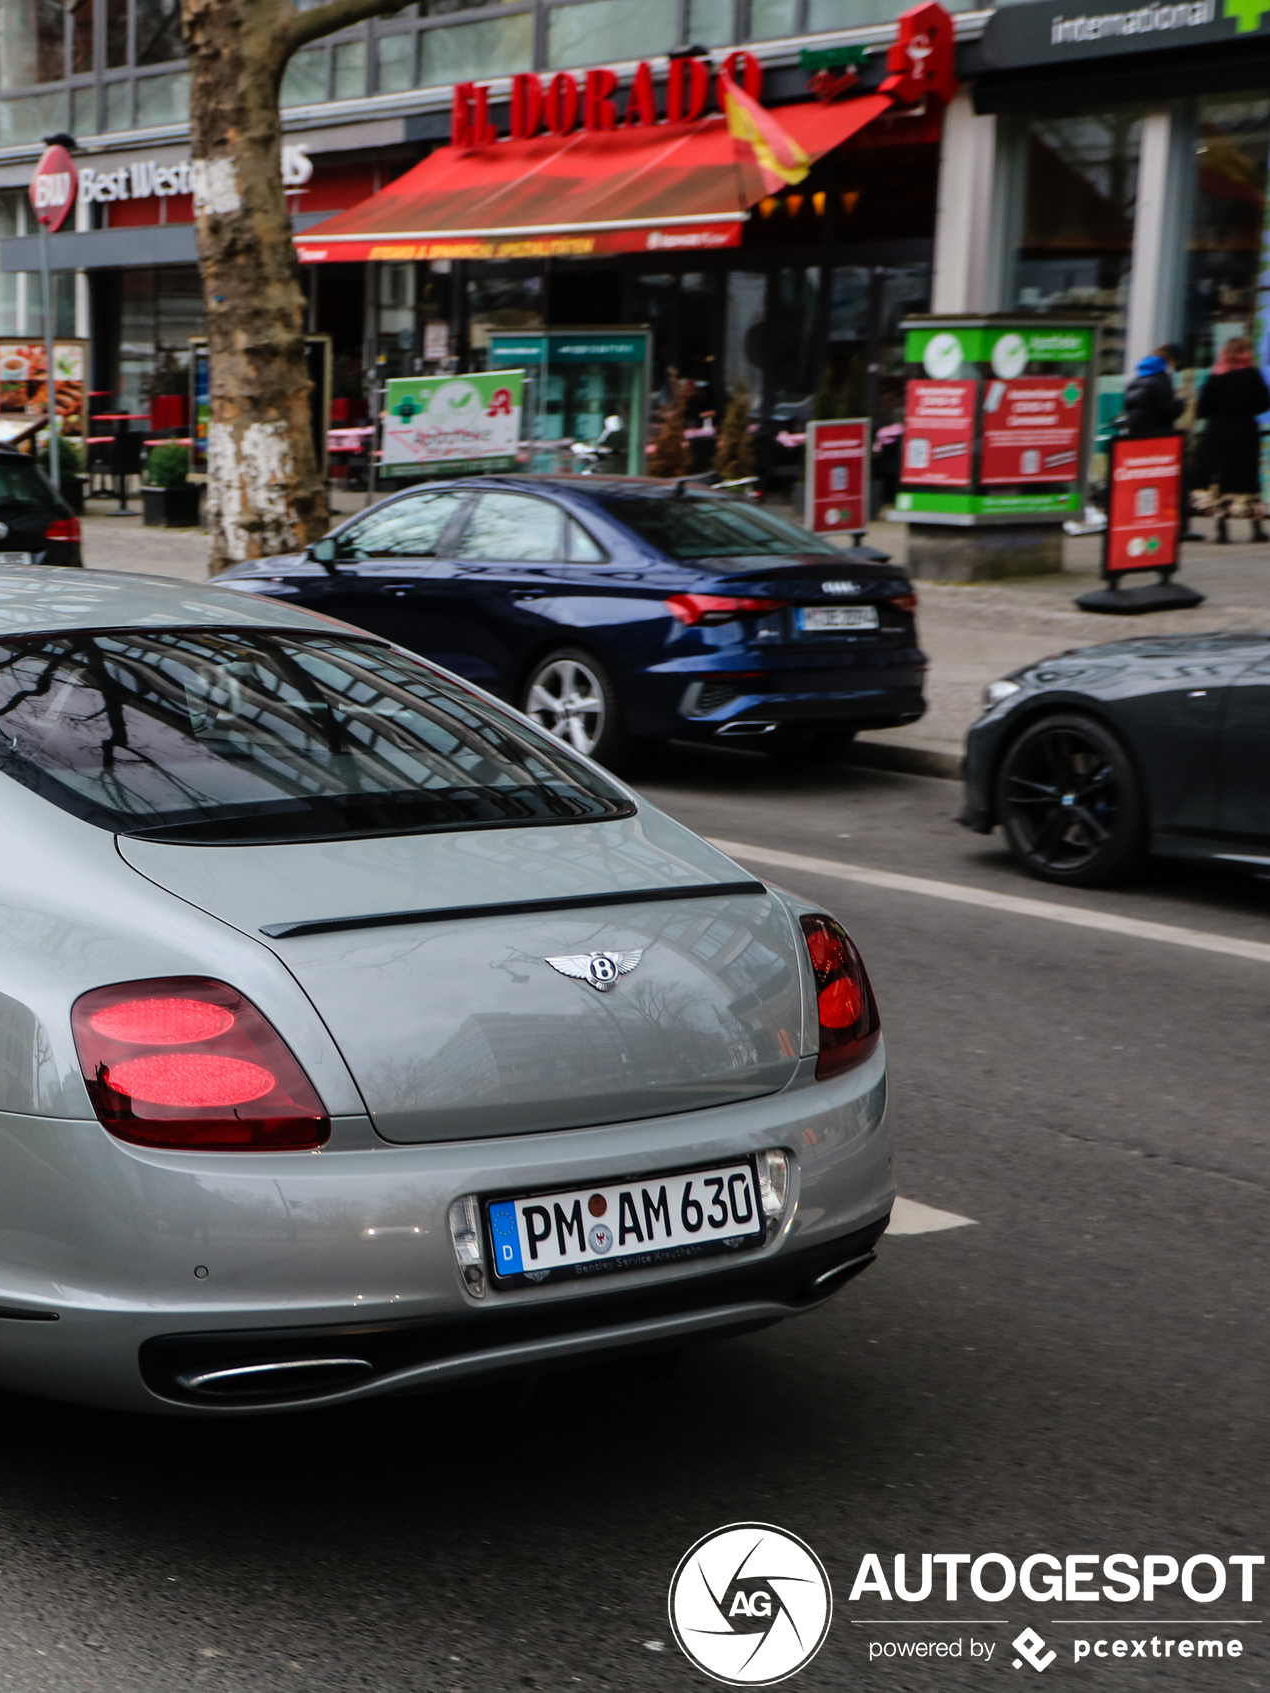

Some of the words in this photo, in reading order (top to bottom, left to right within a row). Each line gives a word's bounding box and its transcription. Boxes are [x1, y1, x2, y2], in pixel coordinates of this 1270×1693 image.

[1051, 0, 1216, 45] international
[451, 81, 498, 147] EL
[509, 50, 764, 140] DORADO
[35, 171, 72, 209] BW
[78, 166, 130, 204] Best
[522, 1199, 587, 1260] PM
[618, 1185, 672, 1246] AM
[680, 1172, 754, 1234] 630
[502, 1244, 514, 1262] D
[575, 1260, 614, 1274] Bentley
[616, 1254, 652, 1268] Service
